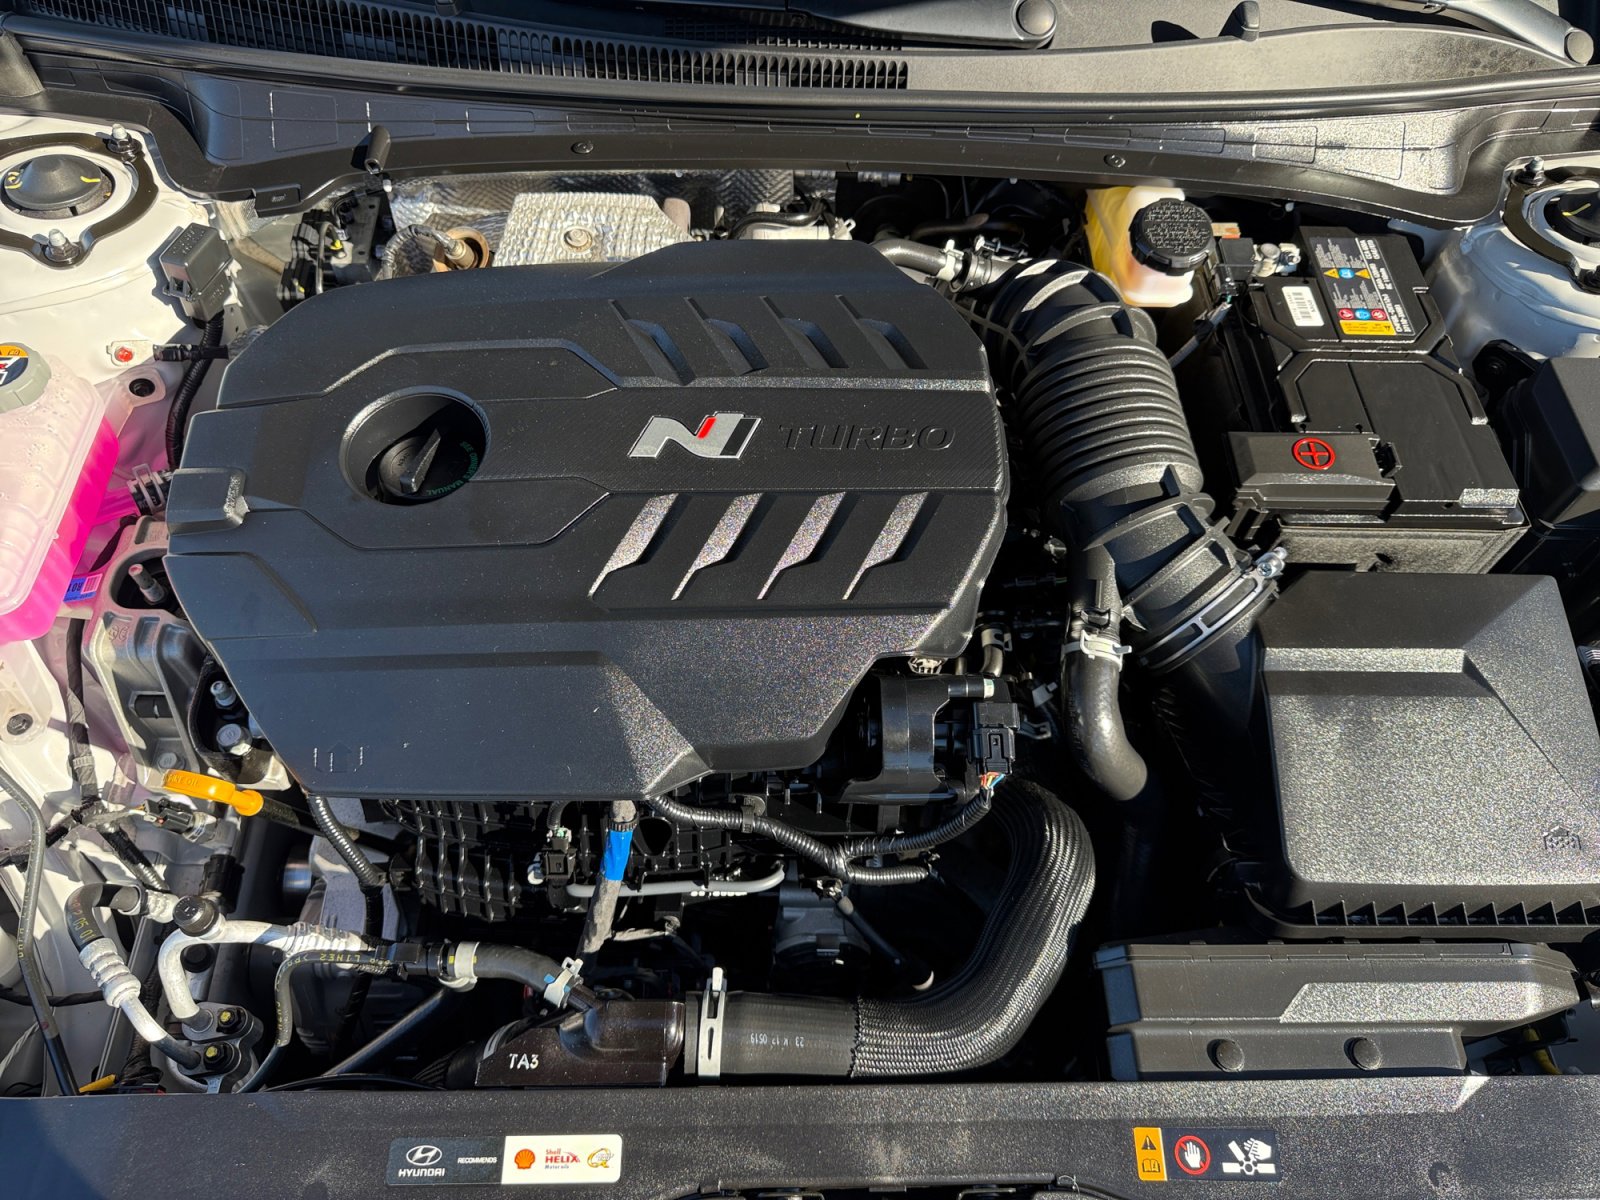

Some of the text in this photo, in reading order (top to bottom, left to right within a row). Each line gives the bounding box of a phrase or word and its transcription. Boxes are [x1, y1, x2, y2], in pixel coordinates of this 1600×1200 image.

[779, 424, 956, 451] TURBO
[426, 480, 464, 496] MANUAL
[319, 953, 361, 963] LINE2
[508, 1053, 539, 1070] TA3
[457, 1156, 498, 1164] RECOMMENDS
[545, 1154, 580, 1164] HELIX
[398, 1168, 446, 1177] HYUNDAI
